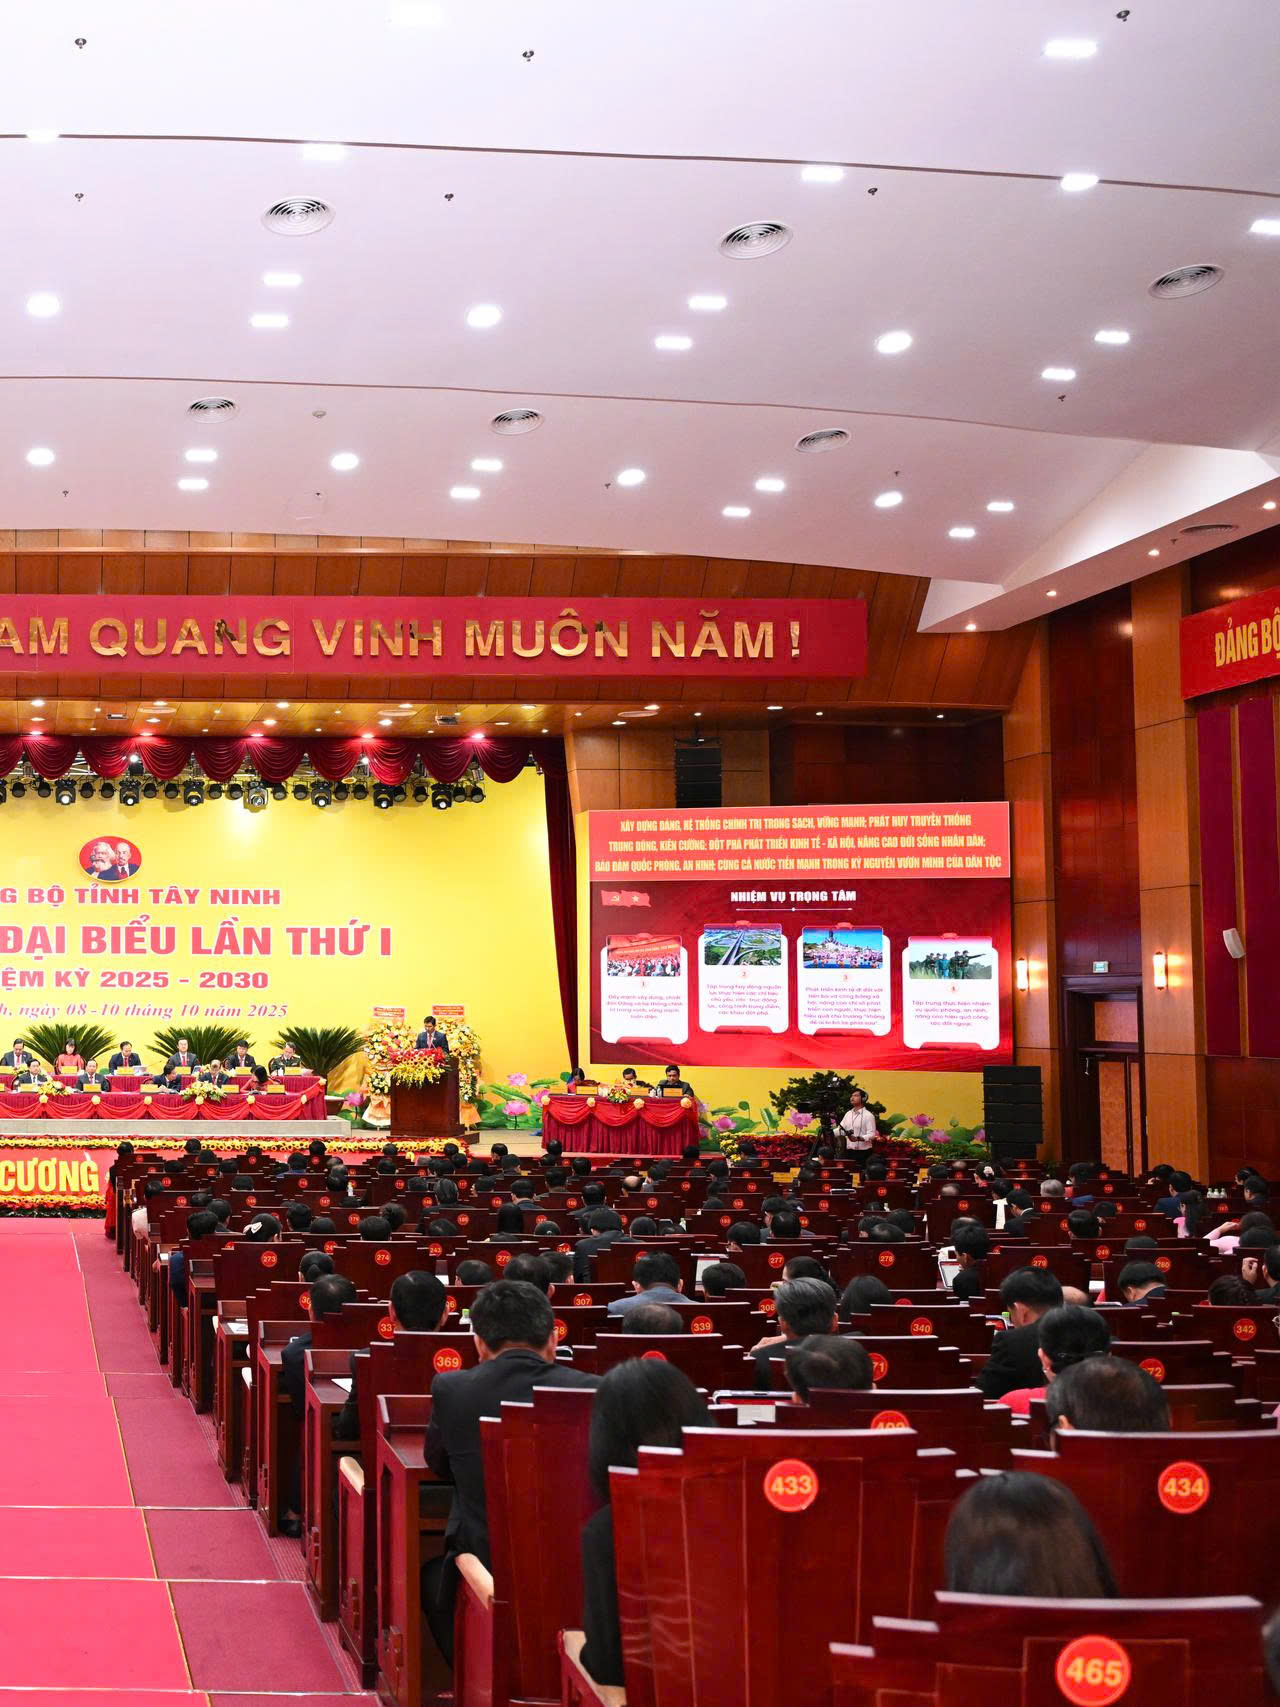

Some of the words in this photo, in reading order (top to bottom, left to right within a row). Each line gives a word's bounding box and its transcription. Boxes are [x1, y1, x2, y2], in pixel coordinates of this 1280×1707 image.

[89, 616, 291, 658] QUANG
[311, 618, 442, 657] VINH
[465, 607, 629, 658] MUÔN
[651, 609, 774, 659] NĂM
[1215, 616, 1259, 667] ĐẢNG
[763, 817, 791, 830] TRONG
[891, 815, 909, 828] HUY
[607, 840, 634, 853] TRUNG
[789, 837, 810, 850] KINH
[821, 857, 850, 870] TRONG
[27, 884, 65, 907] BỘ
[74, 882, 139, 905] TỈNH
[148, 885, 200, 905] TÂY
[210, 889, 281, 905] NINH
[730, 889, 767, 904] NHIỆM
[769, 891, 786, 904] VỤ
[789, 890, 828, 904] TRỌNG
[831, 889, 857, 902] TÂM
[81, 914, 176, 955] BIỂU
[191, 916, 271, 956] LẦN
[285, 919, 371, 956] THỨ
[380, 927, 391, 956] I
[55, 967, 90, 988] KỲ
[100, 971, 169, 988] 2025
[199, 971, 269, 989] 2030
[19, 1003, 60, 1019] ngày
[124, 1003, 174, 1019] tháng
[180, 1003, 200, 1017] 10
[204, 1004, 241, 1017] năm
[247, 1003, 288, 1018] 2025
[880, 1255, 894, 1263] 278
[575, 1298, 590, 1306] 307
[760, 1304, 776, 1312] 308
[693, 1322, 712, 1331] 339
[912, 1323, 931, 1332] 340
[1236, 1324, 1255, 1334] 342
[436, 1355, 459, 1367] 369
[769, 1475, 812, 1495] 433
[1163, 1478, 1205, 1496] 434
[1065, 1657, 1123, 1687] 465
